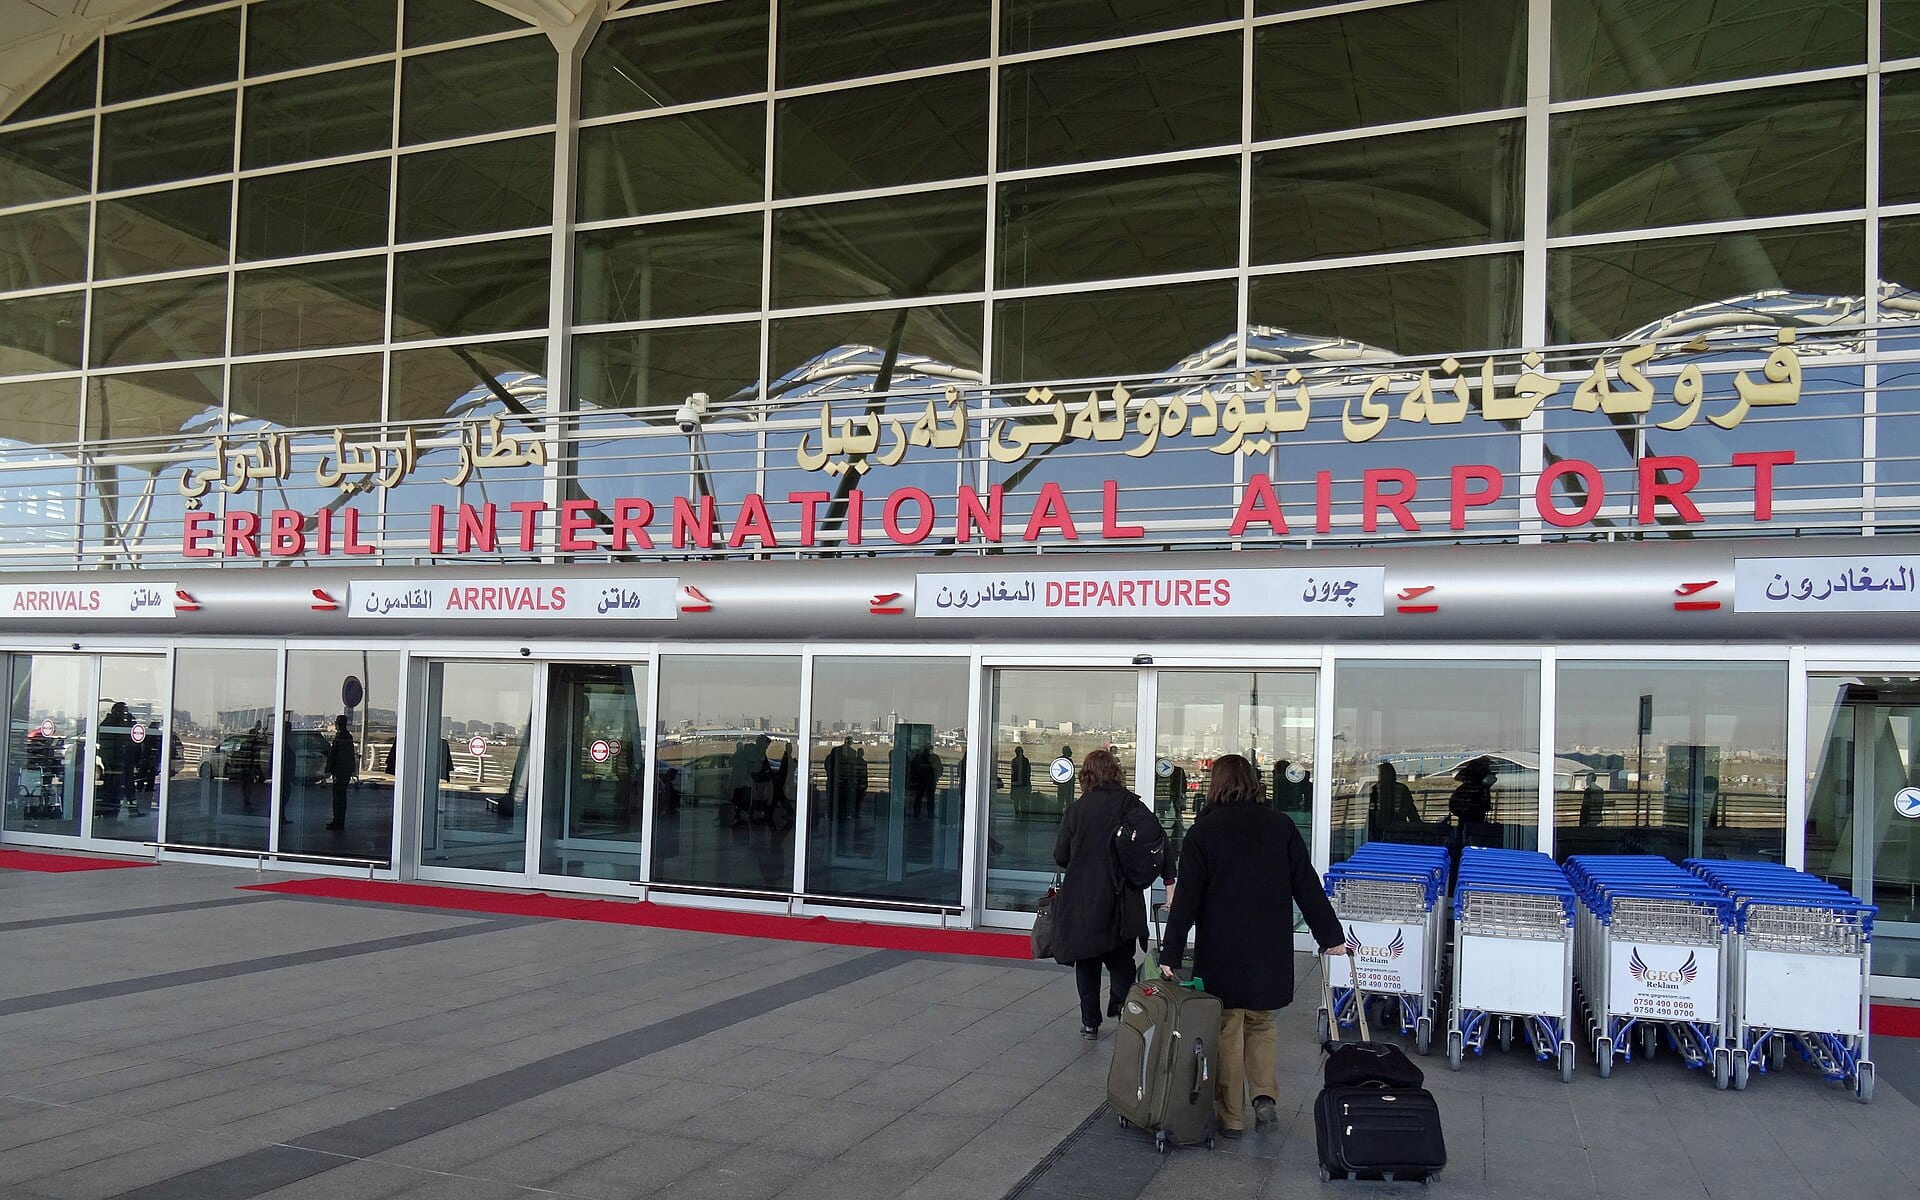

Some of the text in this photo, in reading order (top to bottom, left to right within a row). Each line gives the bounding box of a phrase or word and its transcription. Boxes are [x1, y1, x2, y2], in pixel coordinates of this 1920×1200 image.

[442, 414, 547, 487] مطار
[183, 449, 1796, 558] ERBIL INTERNATIONAL AIRPORT
[935, 579, 1036, 609] المغادرون
[1045, 578, 1231, 607] DEPARTURES
[1765, 565, 1915, 600] المغادرون
[13, 590, 100, 611] ARRIVALS
[130, 588, 162, 611] هاتن
[365, 588, 432, 614] القادمون
[446, 587, 566, 611] ARRIVALS
[597, 587, 640, 614] هاتن
[1360, 945, 1389, 957] GEG
[1360, 956, 1389, 964] Reklam
[1349, 971, 1366, 979] 050
[1368, 973, 1381, 981] 490
[1646, 970, 1680, 982] GEG
[1646, 981, 1679, 990] Reklam
[1633, 998, 1694, 1009] 0750 490 0600
[1634, 1006, 1654, 1014] 0750
[1674, 1009, 1694, 1017] 0700
